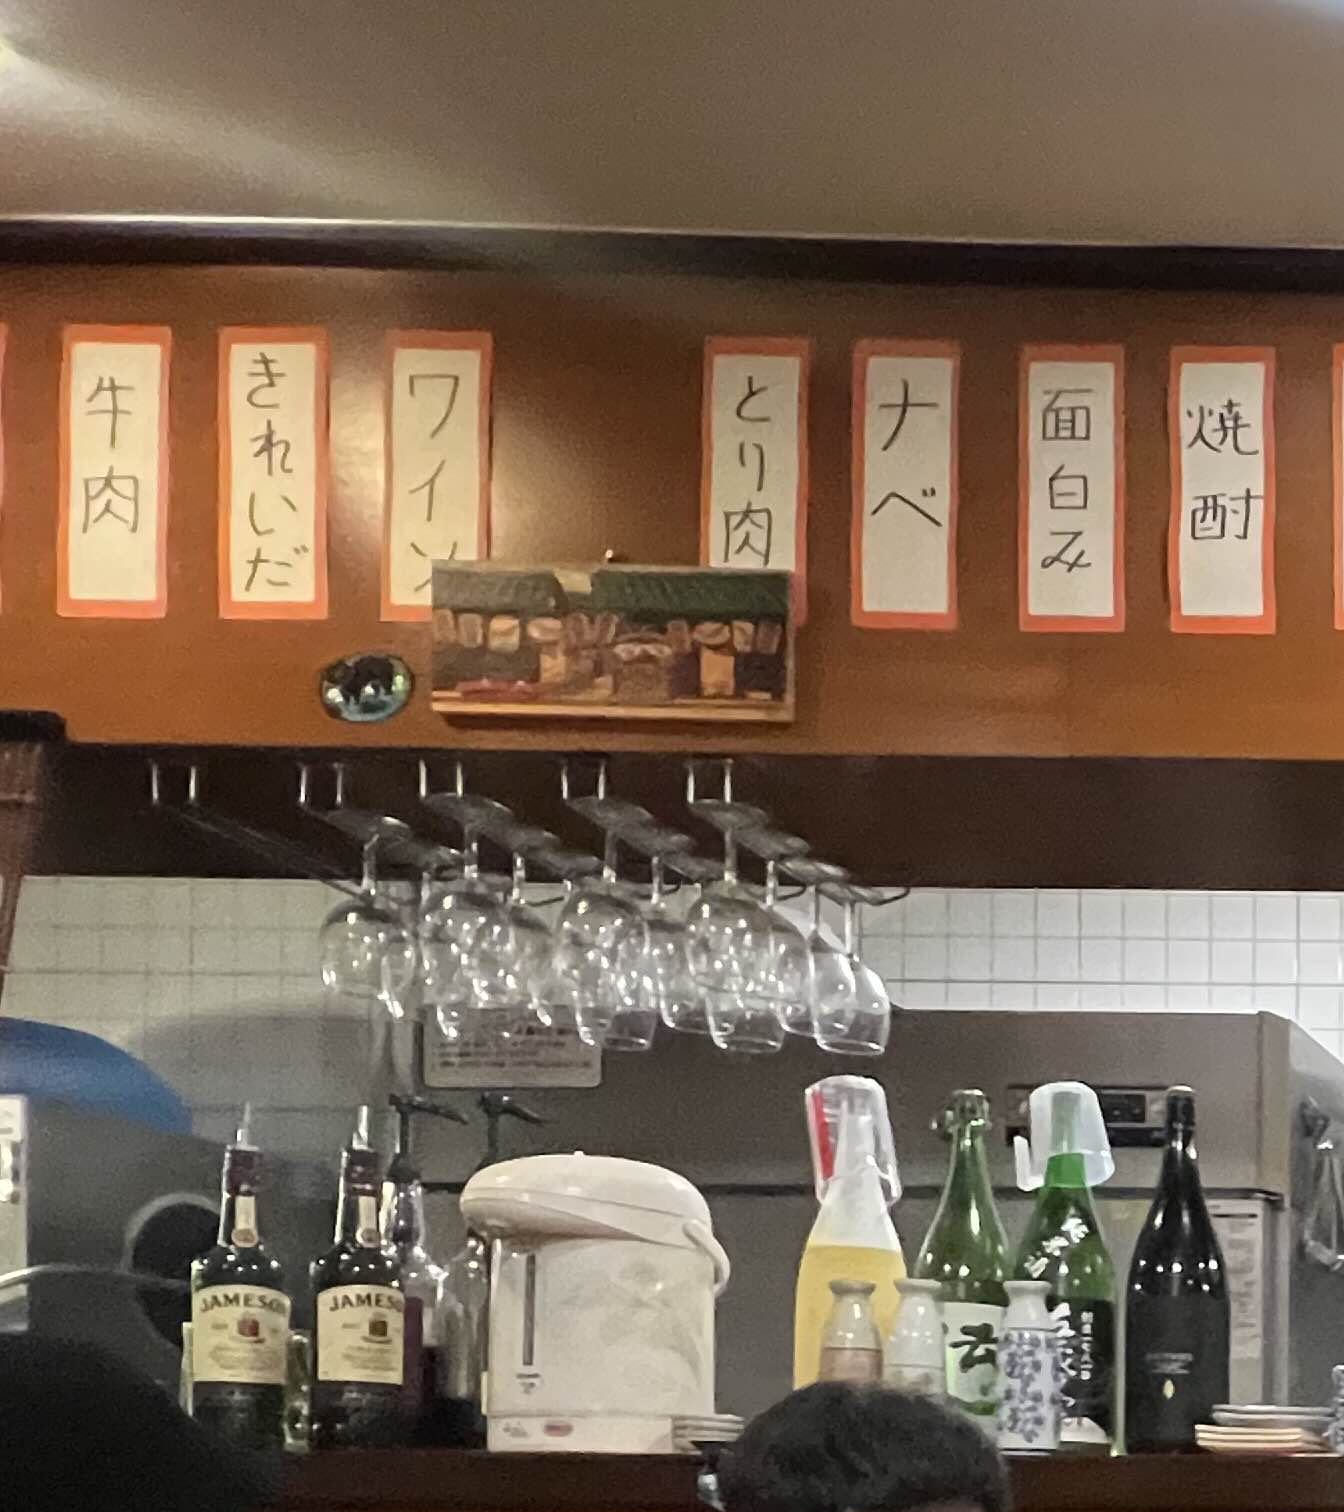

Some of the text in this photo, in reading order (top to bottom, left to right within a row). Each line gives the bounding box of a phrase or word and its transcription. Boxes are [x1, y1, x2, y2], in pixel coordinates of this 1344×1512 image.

[81, 374, 141, 535] 牛肉
[244, 352, 310, 593] きれいだ
[721, 375, 774, 566] とり肉
[1041, 387, 1094, 573] 面白み
[1185, 398, 1265, 541] 焼酎
